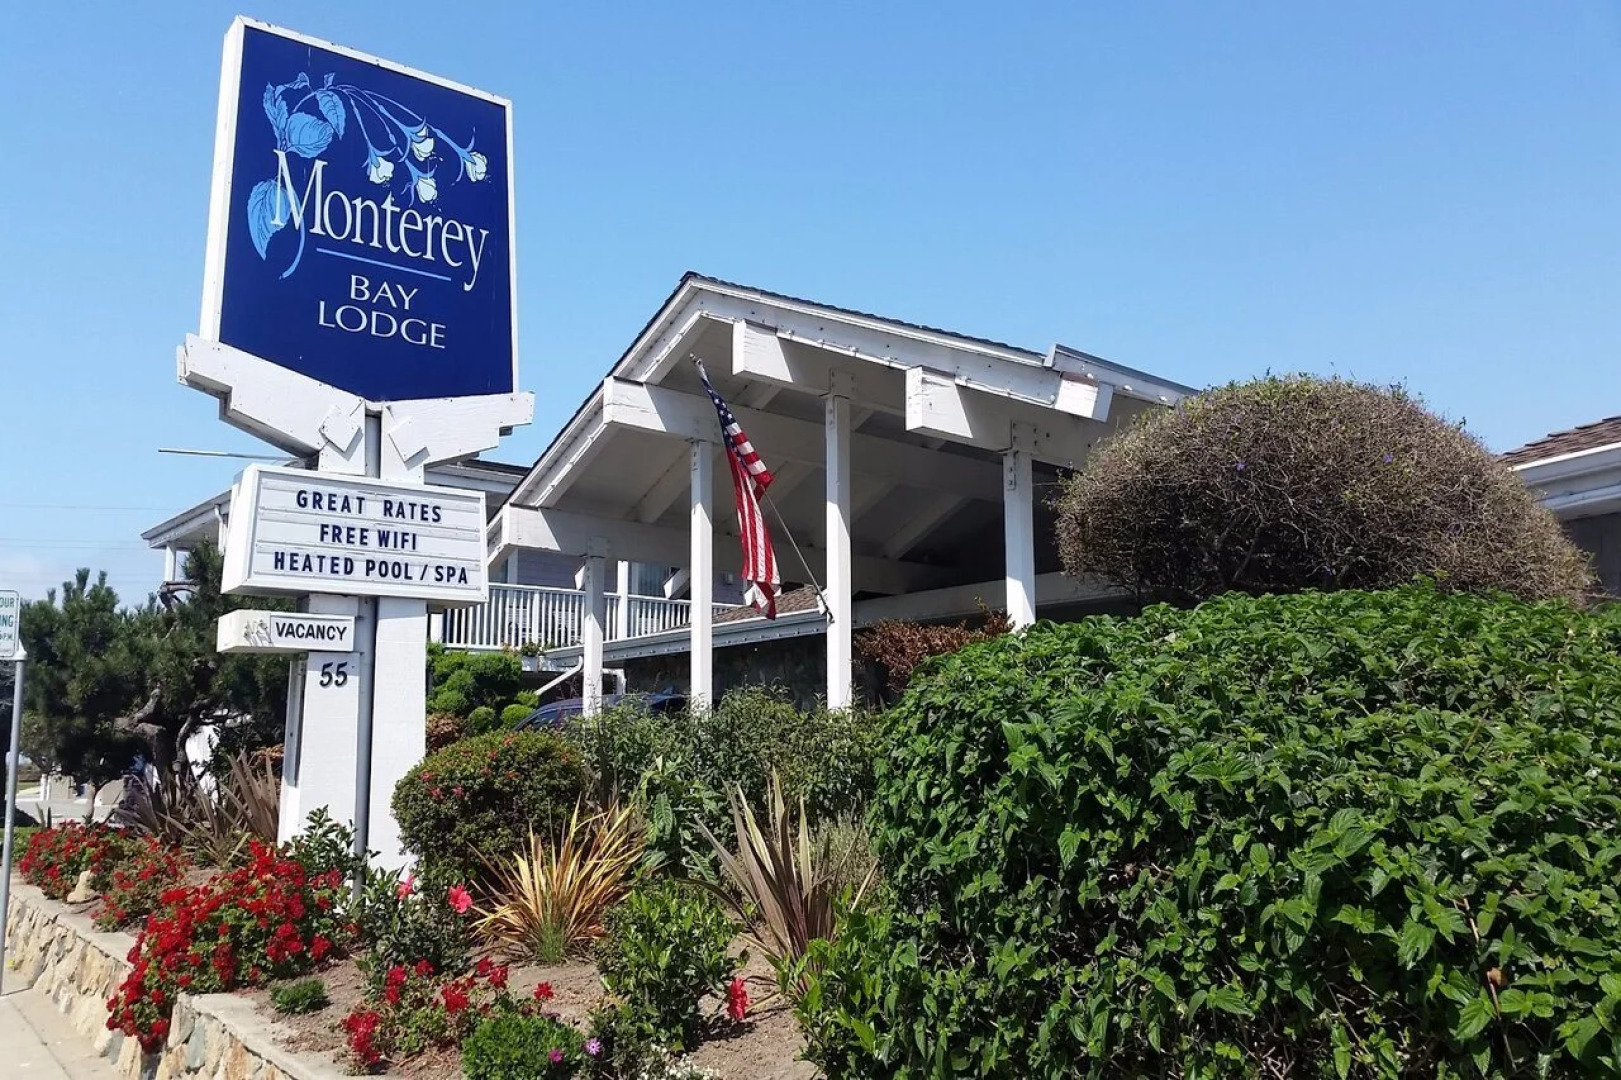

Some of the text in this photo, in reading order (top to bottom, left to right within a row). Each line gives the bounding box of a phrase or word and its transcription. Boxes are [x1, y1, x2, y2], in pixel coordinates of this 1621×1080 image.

[270, 149, 489, 290] Monterey
[350, 274, 418, 309] BAY
[318, 301, 446, 348] LODGE
[296, 490, 442, 523] GREAT RATES
[319, 524, 417, 550] FREE WIFI
[275, 552, 354, 576] HEATED
[275, 622, 347, 641] VACANCY
[319, 661, 348, 687] 55
